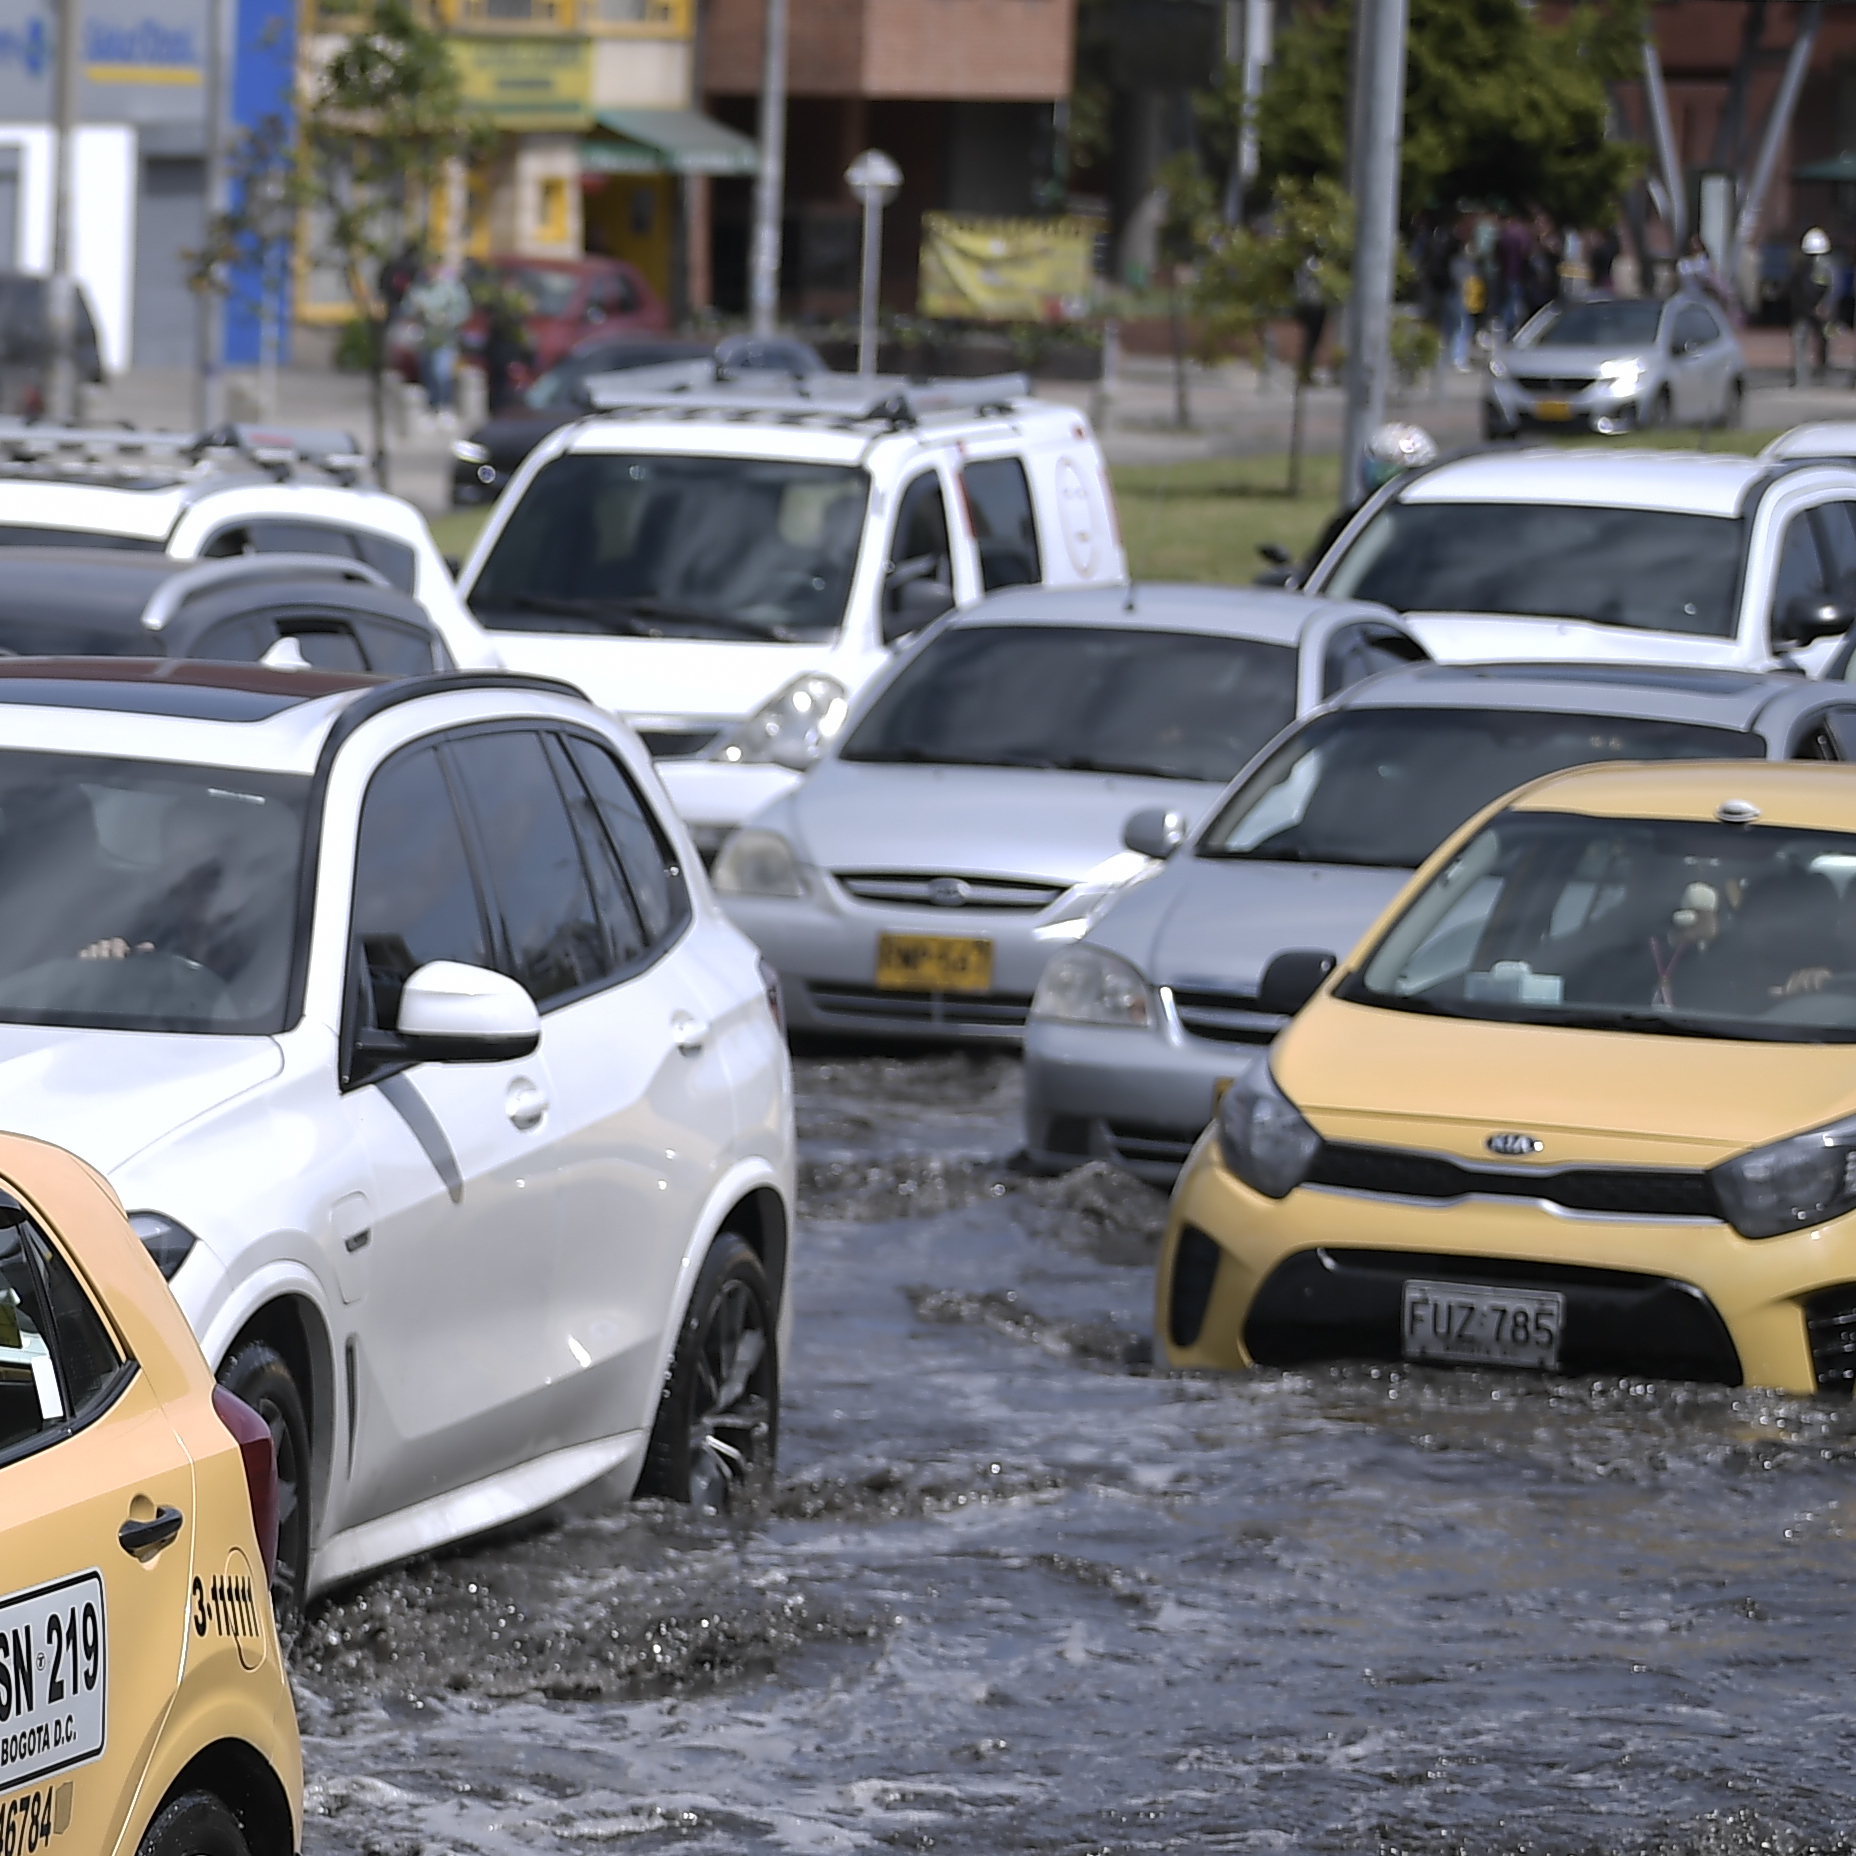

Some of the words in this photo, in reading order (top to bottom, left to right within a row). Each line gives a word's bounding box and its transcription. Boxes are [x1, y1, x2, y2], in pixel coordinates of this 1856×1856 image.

[1410, 1298, 1475, 1341] FUZ
[1491, 1304, 1554, 1347] 785
[46, 1602, 99, 1705] 219
[0, 1722, 51, 1767] BOGOTA
[53, 1714, 77, 1748] D.C.
